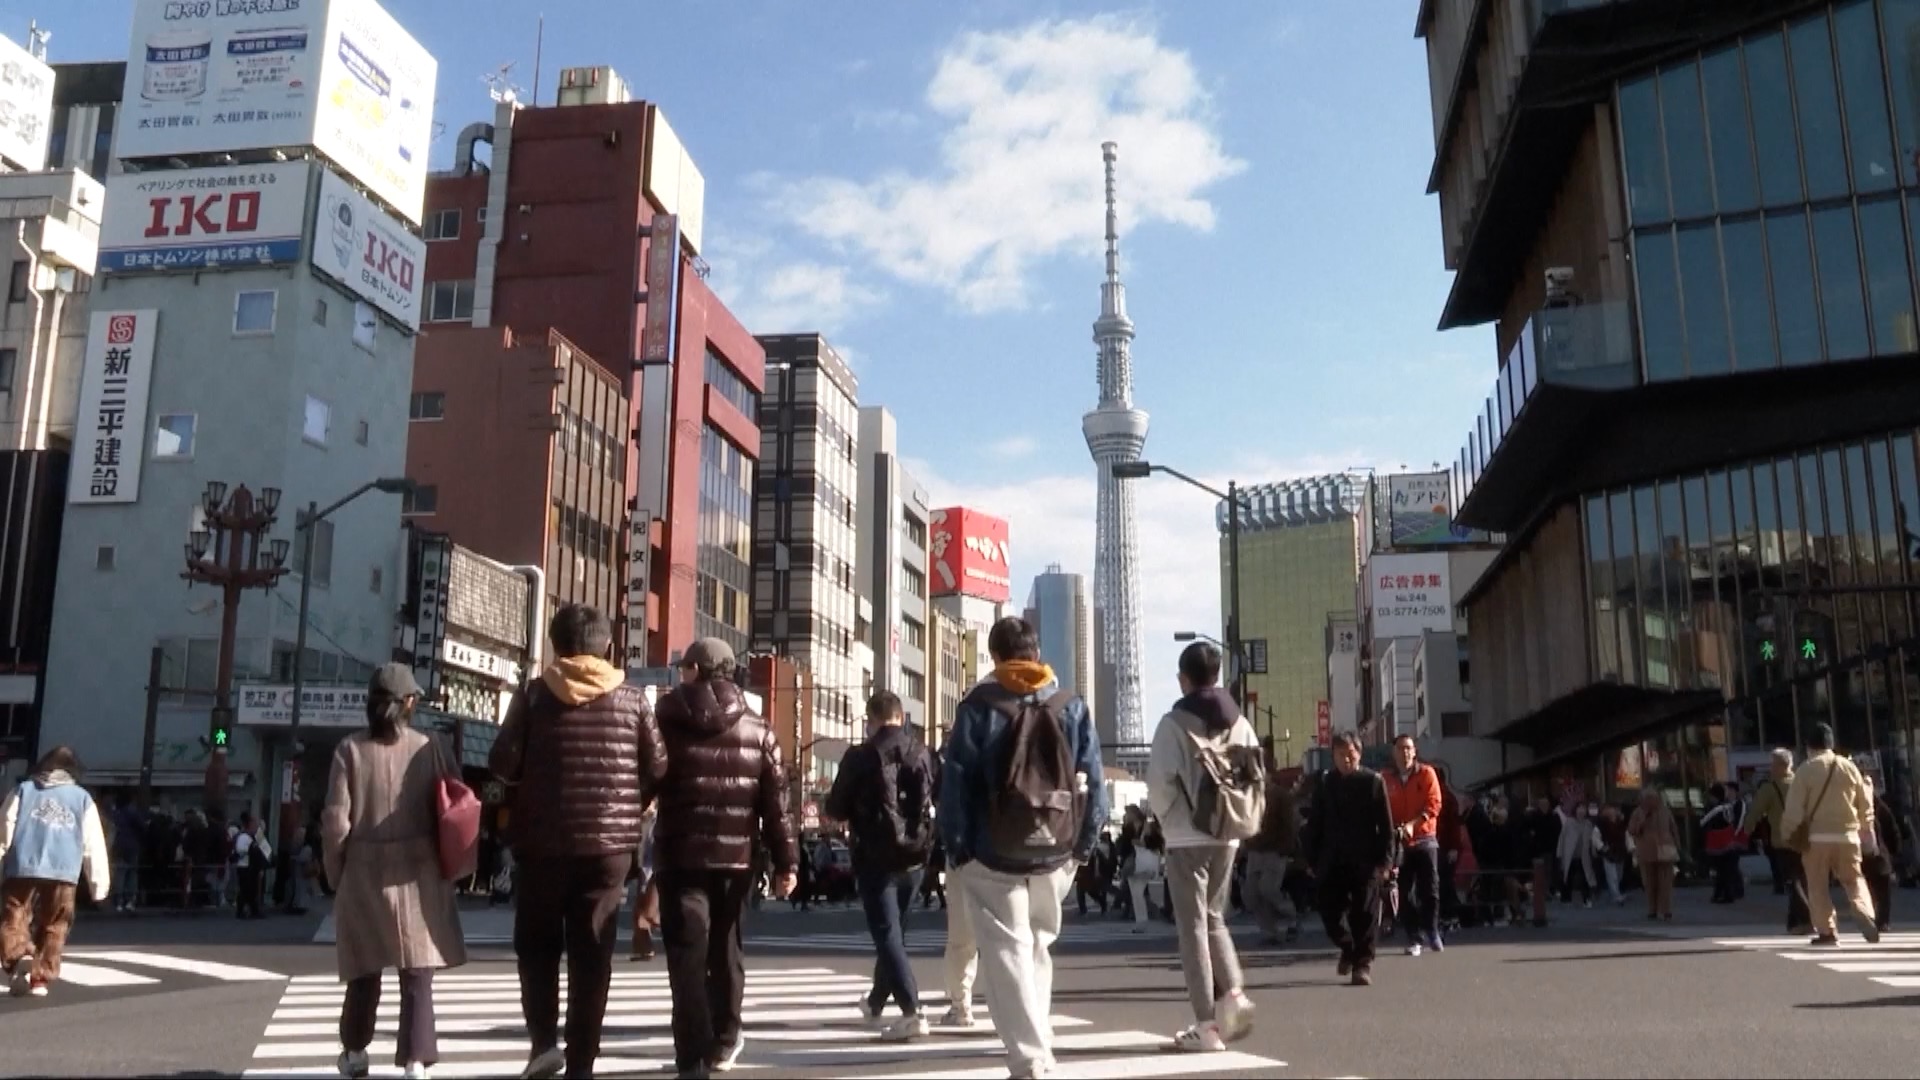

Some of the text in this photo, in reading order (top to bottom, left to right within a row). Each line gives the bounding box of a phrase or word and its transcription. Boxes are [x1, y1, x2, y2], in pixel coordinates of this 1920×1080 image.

[144, 191, 261, 238] IKO
[124, 245, 271, 267] 日本トムソン株式会社
[364, 230, 414, 294] IKO
[361, 268, 411, 309] 日本トムソン
[90, 347, 131, 496] 新三平建設
[1380, 575, 1442, 590] 広告募集
